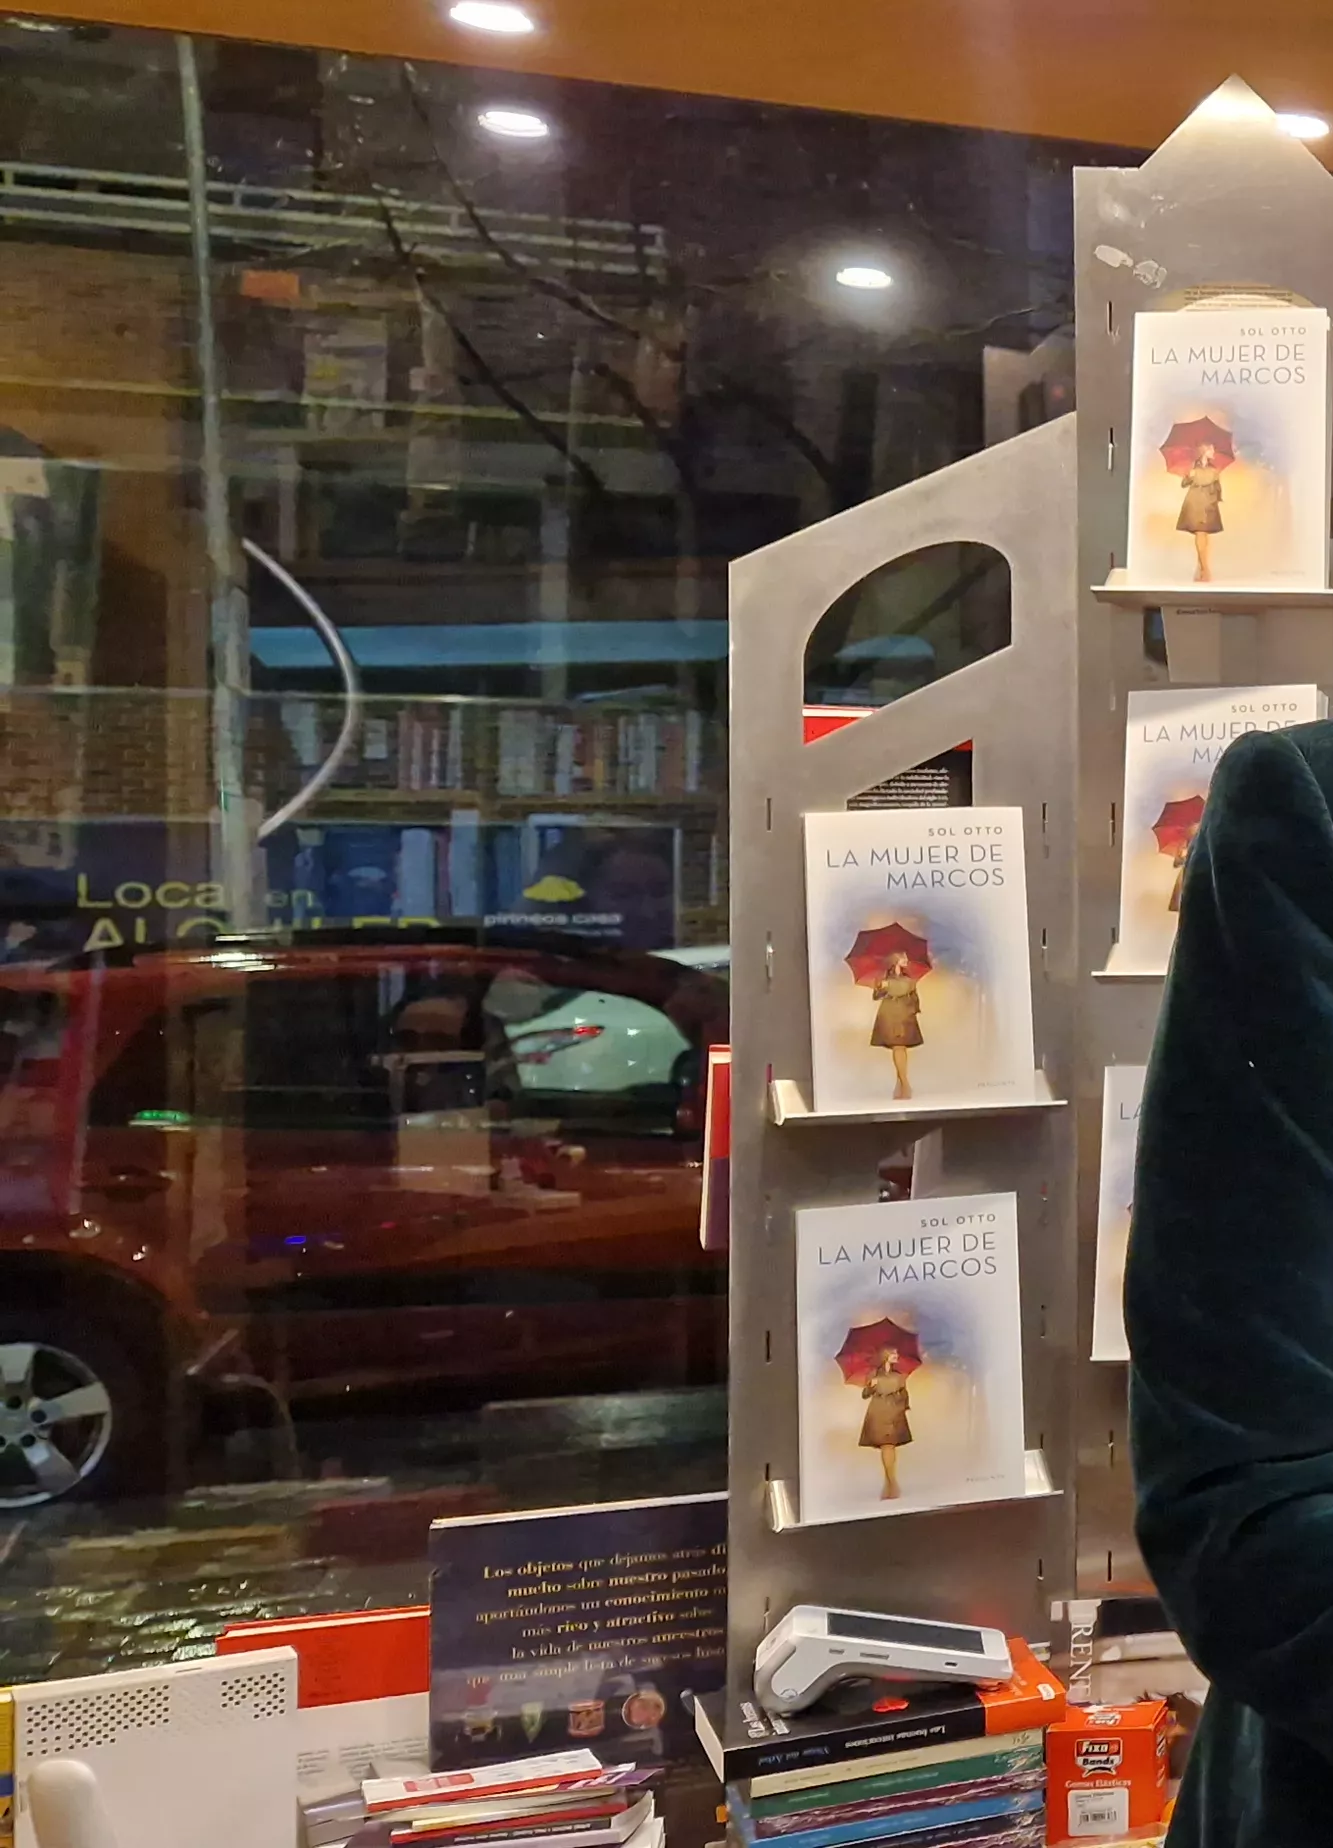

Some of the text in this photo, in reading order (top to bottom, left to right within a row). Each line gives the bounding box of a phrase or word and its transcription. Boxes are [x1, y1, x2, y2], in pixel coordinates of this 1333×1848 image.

[1240, 327, 1307, 337] SOL OTTO
[1151, 343, 1306, 365] LA MUJER DE
[1202, 366, 1307, 386] MARCOS
[1231, 703, 1298, 713] SOL OTTO
[1143, 725, 1171, 743] LA
[928, 826, 1003, 837] SOL OTTO
[827, 844, 1003, 868] LA MUJER DE
[887, 867, 1005, 890] MARCOS
[77, 872, 226, 909] Loca
[920, 1213, 997, 1228] SOL OTTO
[818, 1232, 997, 1266] LA MUJER DE
[878, 1256, 998, 1285] MARCOS
[484, 1564, 513, 1580] Los
[517, 1560, 574, 1578] objetos
[507, 1581, 562, 1598] mucho
[608, 1571, 668, 1588] nuestro
[604, 1588, 709, 1608] conocimiento
[522, 1626, 552, 1638] más
[556, 1620, 589, 1635] rico
[606, 1611, 675, 1629] atractivo
[512, 1646, 525, 1660] la
[530, 1642, 562, 1657] vida
[566, 1640, 584, 1653] de
[1082, 1757, 1115, 1767] Bands
